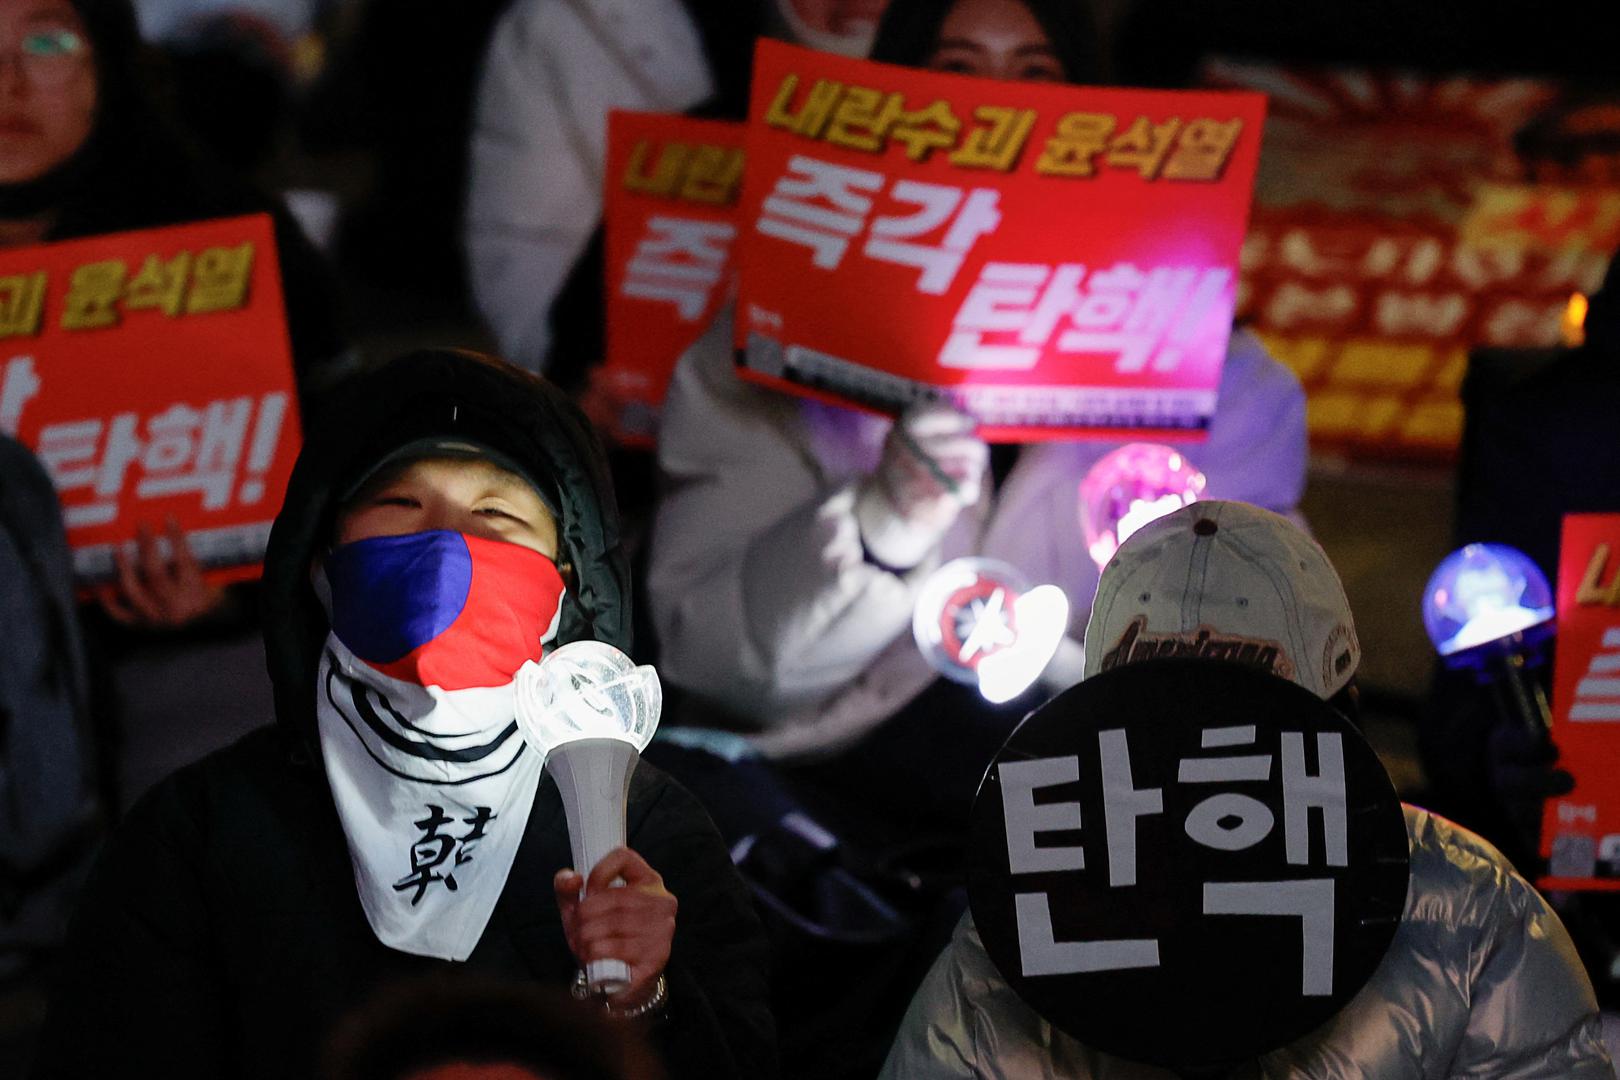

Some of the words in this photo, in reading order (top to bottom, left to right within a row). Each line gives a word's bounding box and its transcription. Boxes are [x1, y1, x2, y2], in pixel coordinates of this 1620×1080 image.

[766, 74, 1037, 172] 내란수괴
[1037, 113, 1243, 181] 윤석열
[756, 155, 1002, 295] 즉각
[61, 243, 254, 330] 윤석열
[937, 262, 1231, 371] 탄핵!
[38, 393, 288, 528] 탄핵!
[997, 724, 1348, 996] 탄핵
